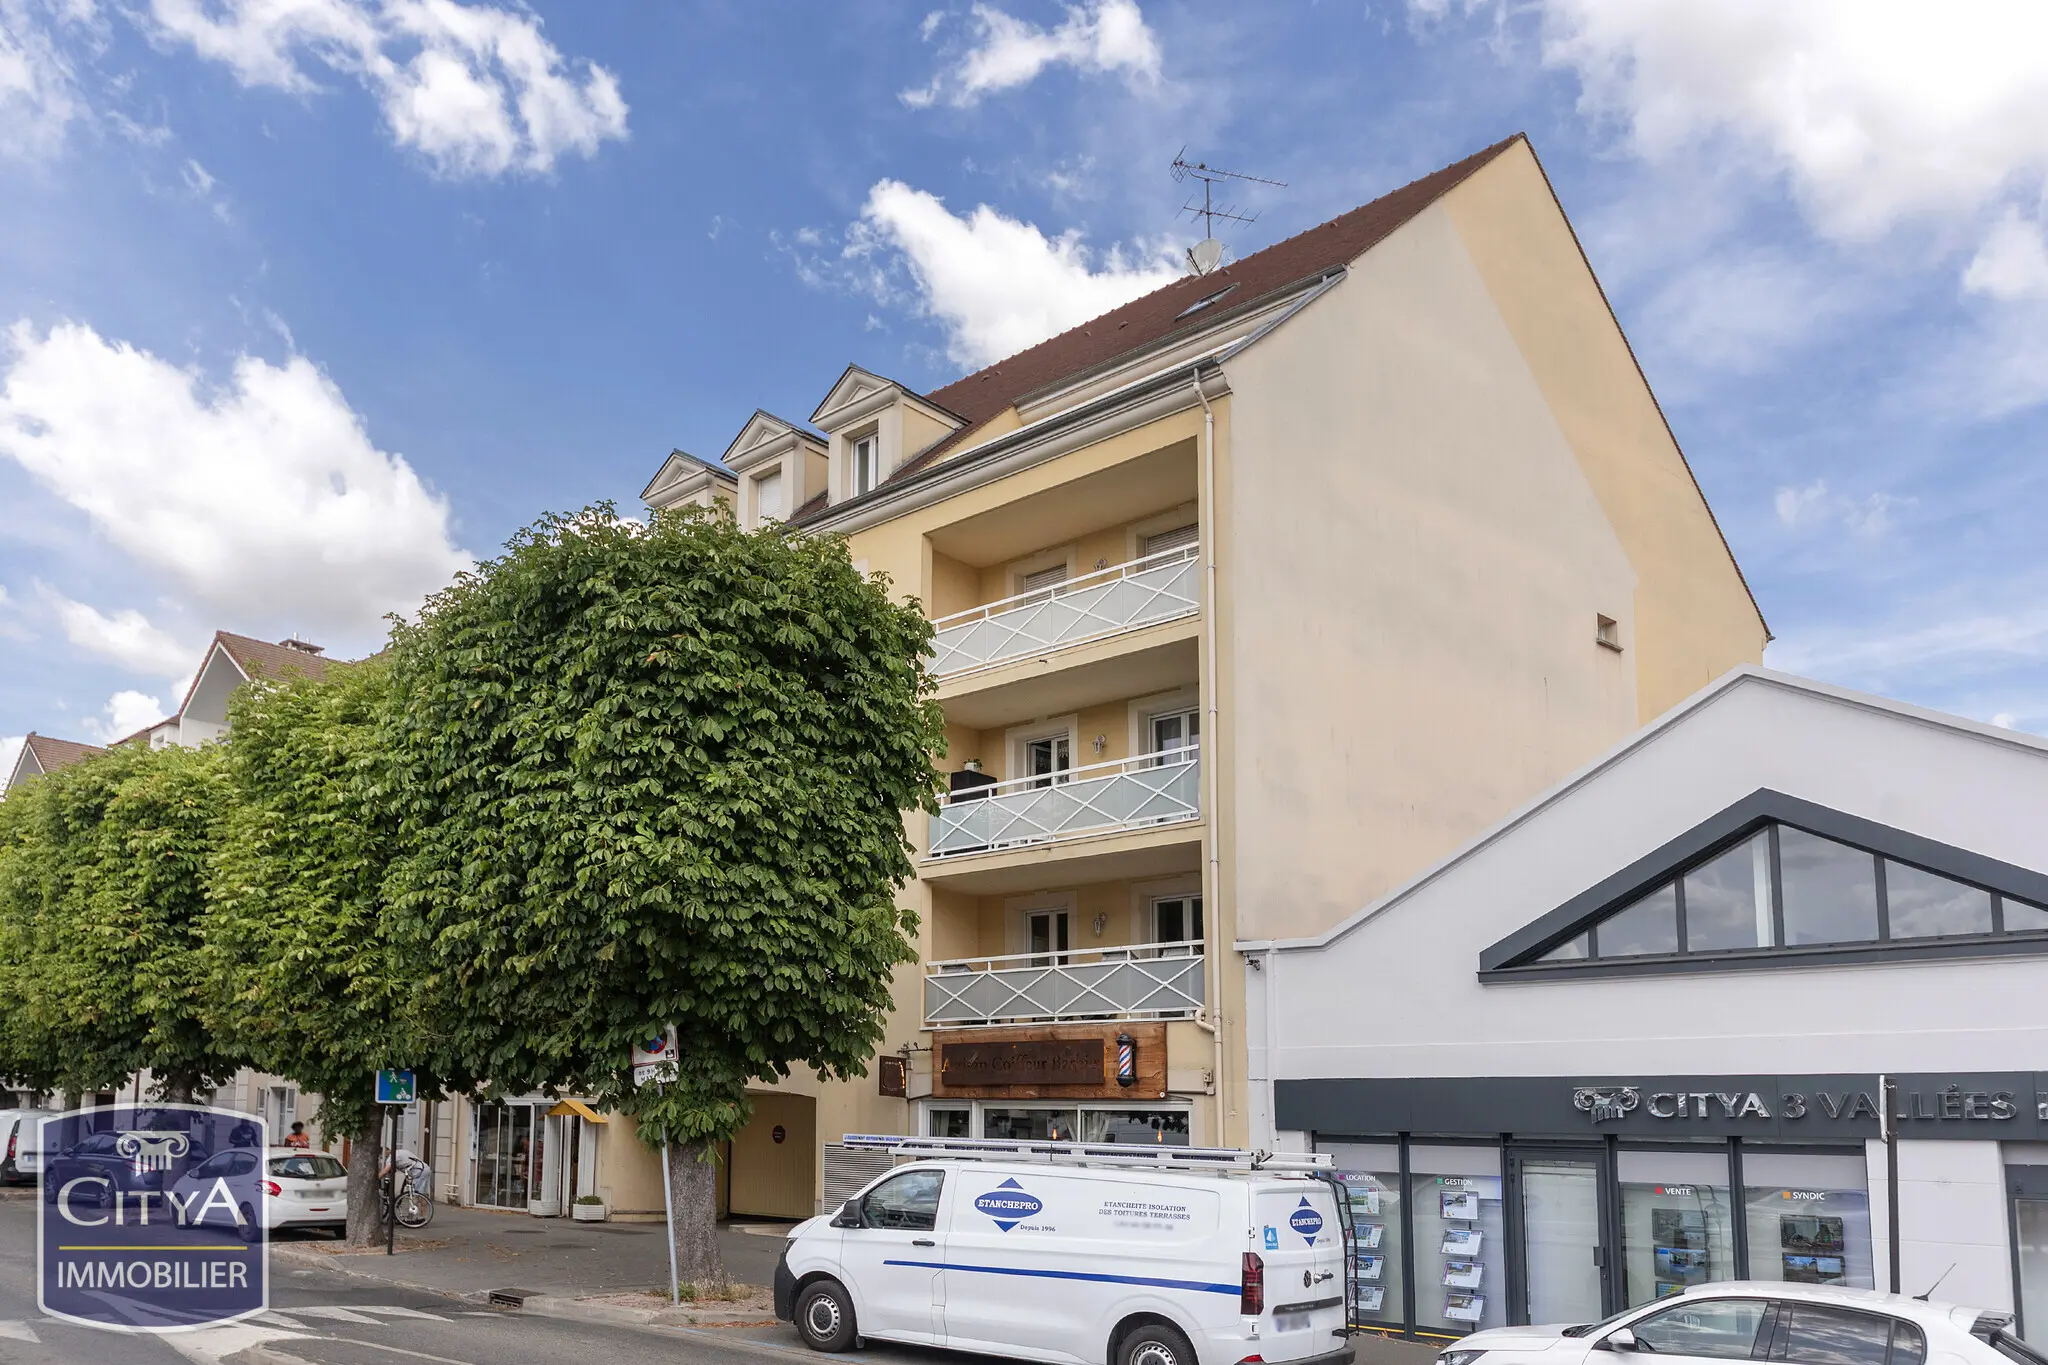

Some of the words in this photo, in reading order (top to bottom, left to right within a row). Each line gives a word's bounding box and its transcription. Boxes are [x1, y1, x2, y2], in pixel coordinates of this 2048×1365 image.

[991, 1054, 1047, 1071] Coiffeur
[1646, 1092, 1772, 1118] CITYA
[1782, 1093, 1807, 1119] 3
[1816, 1083, 2017, 1120] VALÉES
[1345, 1174, 1376, 1182] LOCATION
[1444, 1178, 1473, 1186] GESTION
[1665, 1187, 1691, 1196] VENTE
[1792, 1191, 1825, 1201] SYNDIC
[977, 1199, 1039, 1211] ETANCHEPRO
[1104, 1201, 1147, 1210] ETANCHEITE
[1148, 1204, 1186, 1212] ISOLATION
[1114, 1209, 1148, 1217] TOITURES
[1149, 1211, 1191, 1220] TERRASSES
[1020, 1224, 1039, 1232] Depuis
